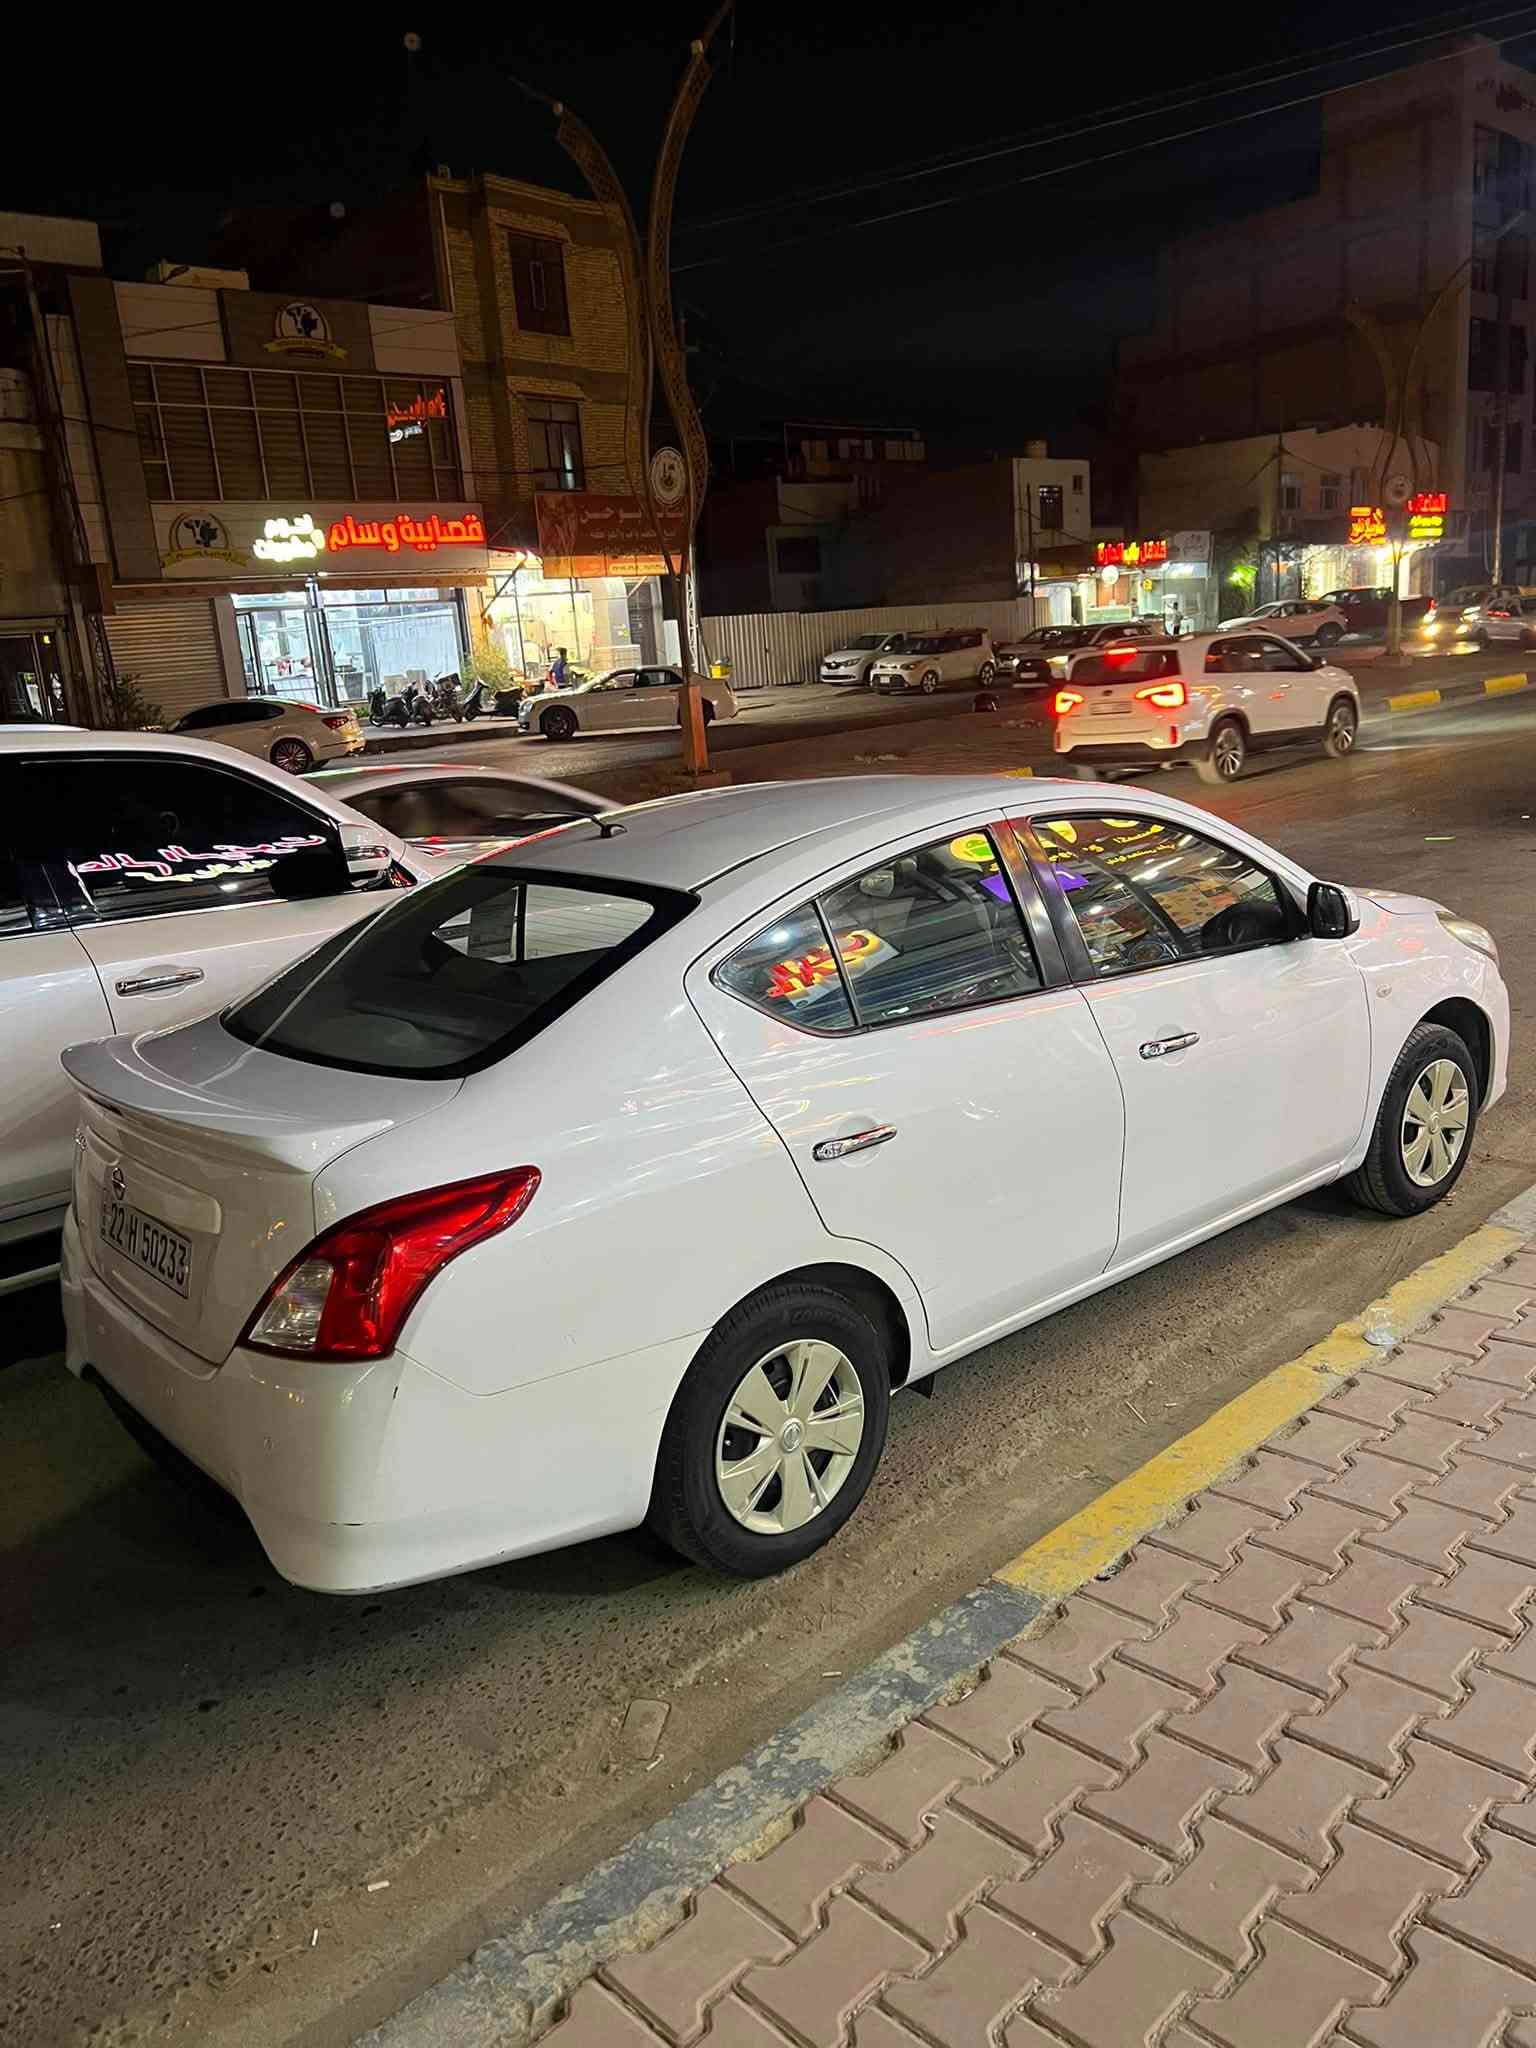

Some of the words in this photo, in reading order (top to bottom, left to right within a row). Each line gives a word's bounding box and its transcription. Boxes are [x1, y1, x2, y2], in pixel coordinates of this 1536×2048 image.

[328, 514, 399, 552] وسام
[399, 513, 485, 551] قصابية
[109, 1202, 126, 1246] 22
[127, 1214, 139, 1255] H
[142, 1222, 187, 1286] 50233
